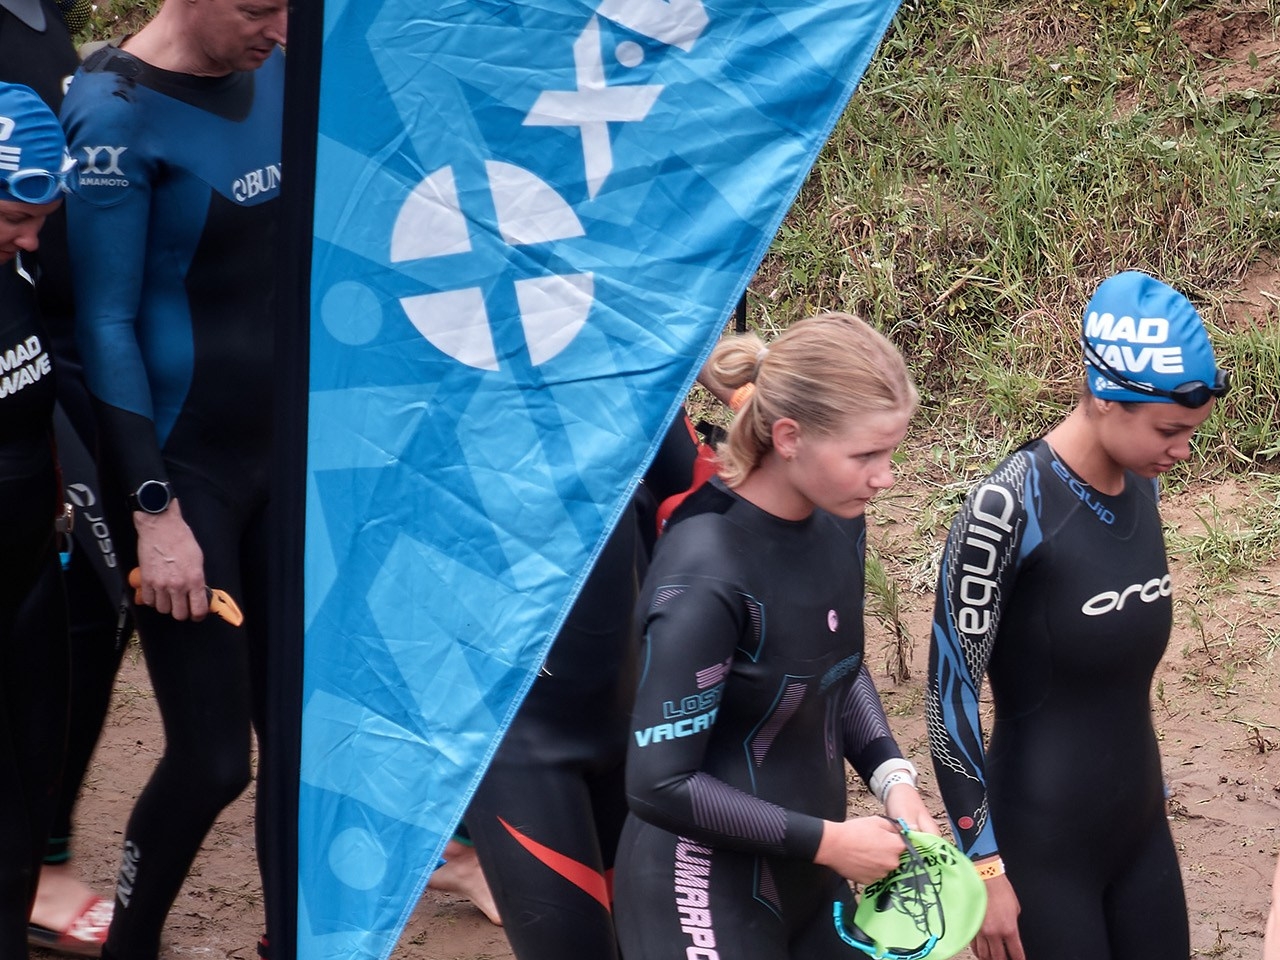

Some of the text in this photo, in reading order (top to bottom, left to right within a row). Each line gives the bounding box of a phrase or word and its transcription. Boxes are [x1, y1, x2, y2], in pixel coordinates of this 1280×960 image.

[78, 178, 129, 187] AMAMOTO
[1085, 311, 1169, 344] MAD
[0, 335, 41, 375] MAD
[1051, 460, 1116, 525] equip
[958, 484, 1015, 635] equip
[662, 682, 725, 719] LOS
